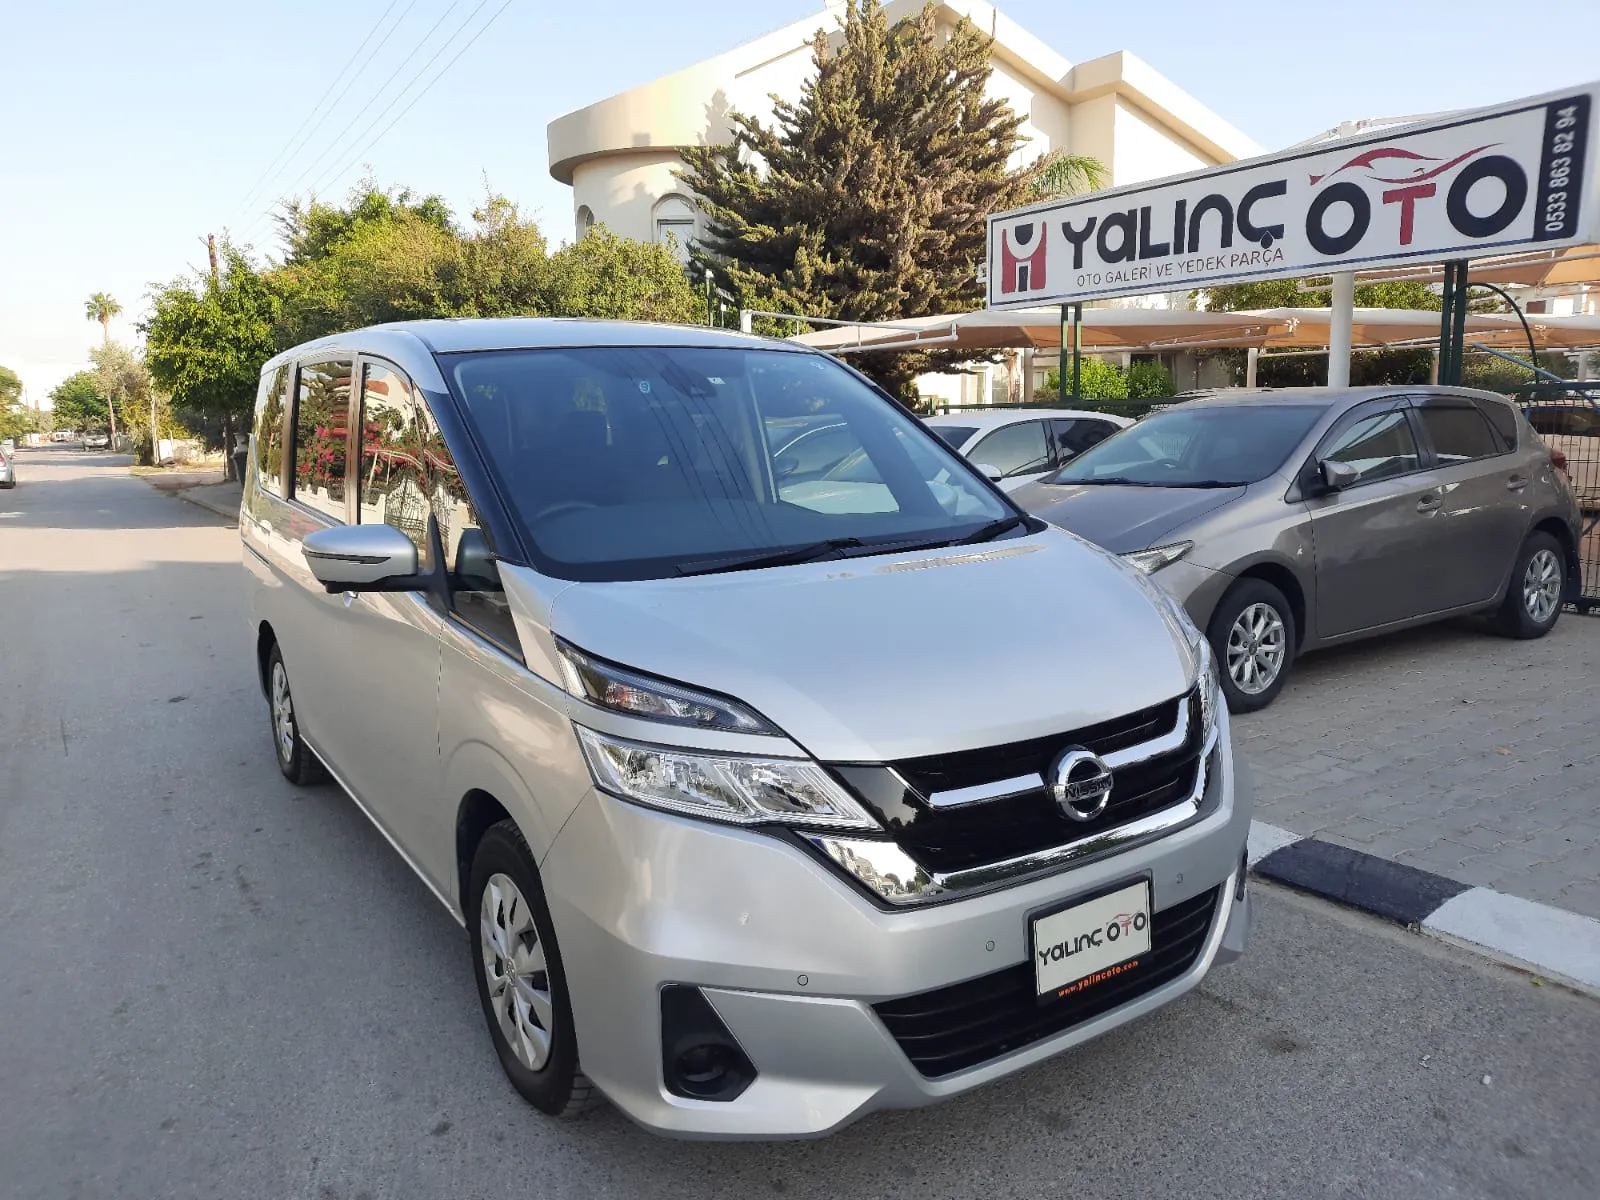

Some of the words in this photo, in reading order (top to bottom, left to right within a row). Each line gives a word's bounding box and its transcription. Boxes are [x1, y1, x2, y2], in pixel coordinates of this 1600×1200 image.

[1555, 105, 1578, 129] 94
[1552, 131, 1575, 154] 82
[1549, 157, 1571, 188] 863
[1306, 155, 1528, 255] OTO
[1545, 191, 1567, 231] 0533
[1077, 272, 1101, 287] OTO
[1105, 263, 1152, 284] GALERİ
[1156, 263, 1173, 278] VE
[1177, 255, 1226, 274] YEDEK
[1230, 248, 1284, 268] PARÇA
[1066, 776, 1111, 799] NISSAN
[1106, 912, 1147, 942] OTO
